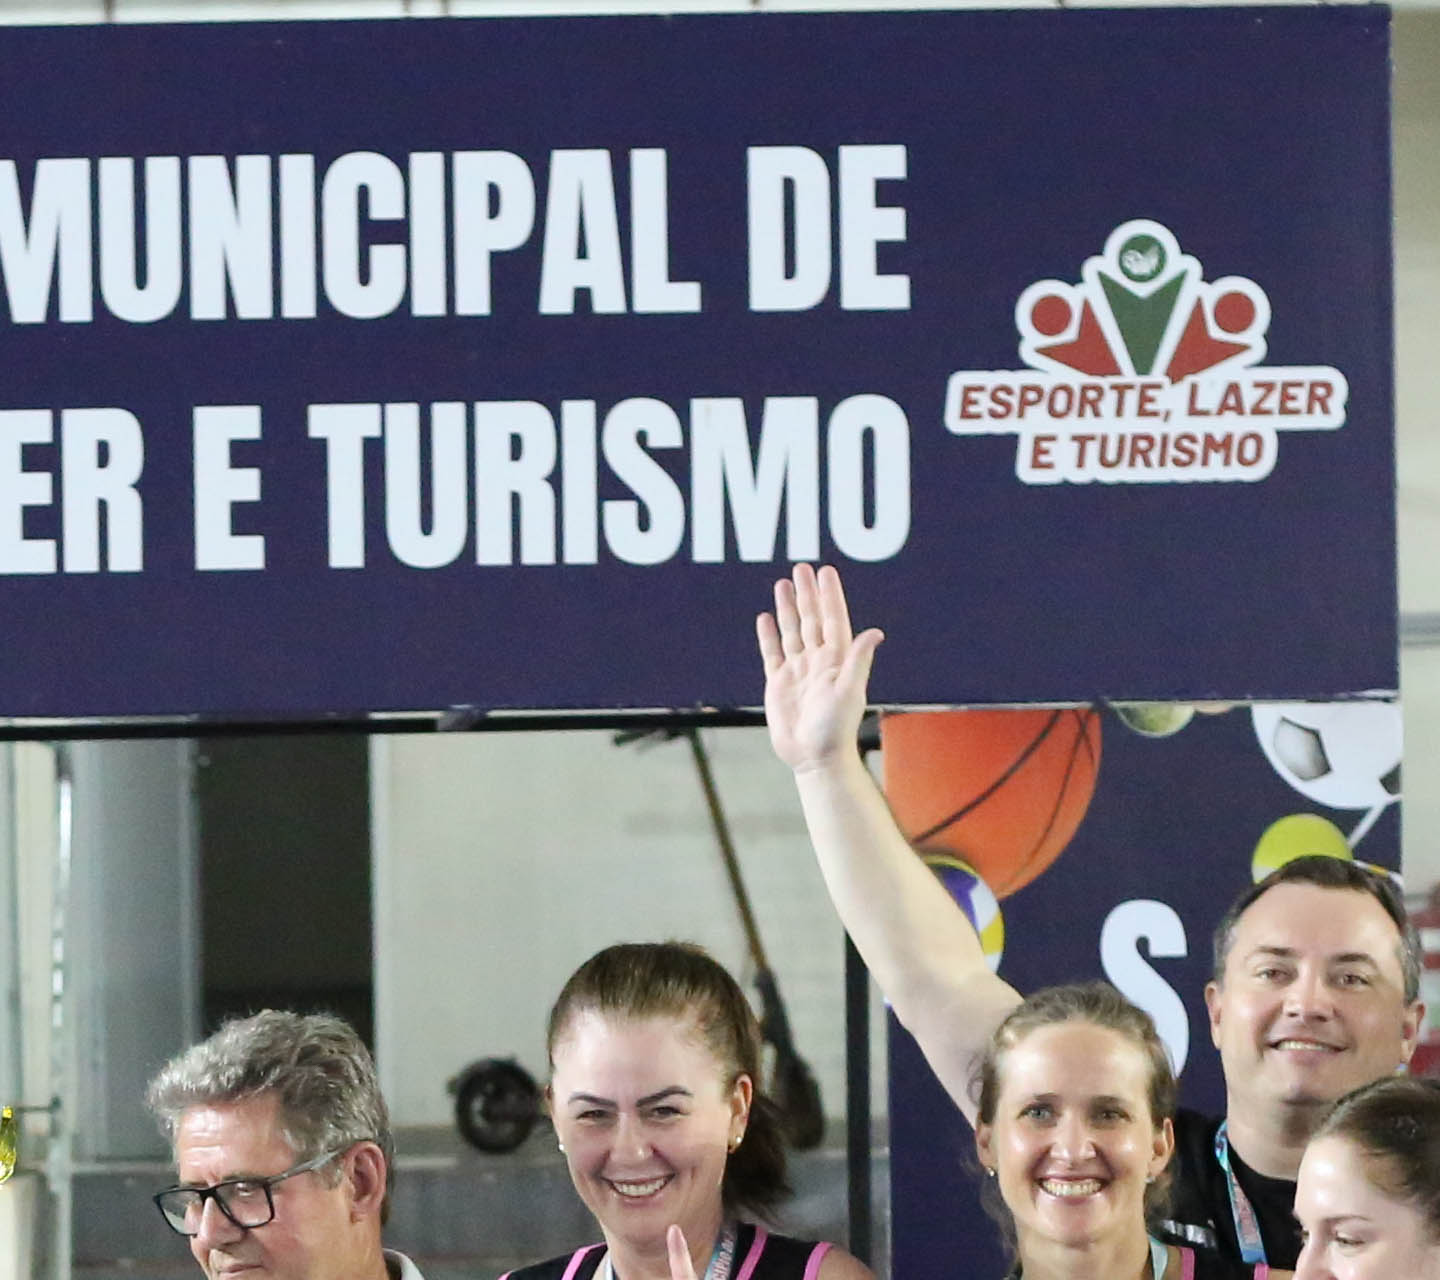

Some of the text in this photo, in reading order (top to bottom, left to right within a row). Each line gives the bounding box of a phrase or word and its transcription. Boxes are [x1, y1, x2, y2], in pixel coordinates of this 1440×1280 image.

[748, 145, 910, 310] DE
[959, 381, 1335, 422] ESPORTE, LAZER
[1030, 432, 1264, 469] E TURISMO
[194, 406, 264, 570] E
[309, 395, 910, 568] TURISMO
